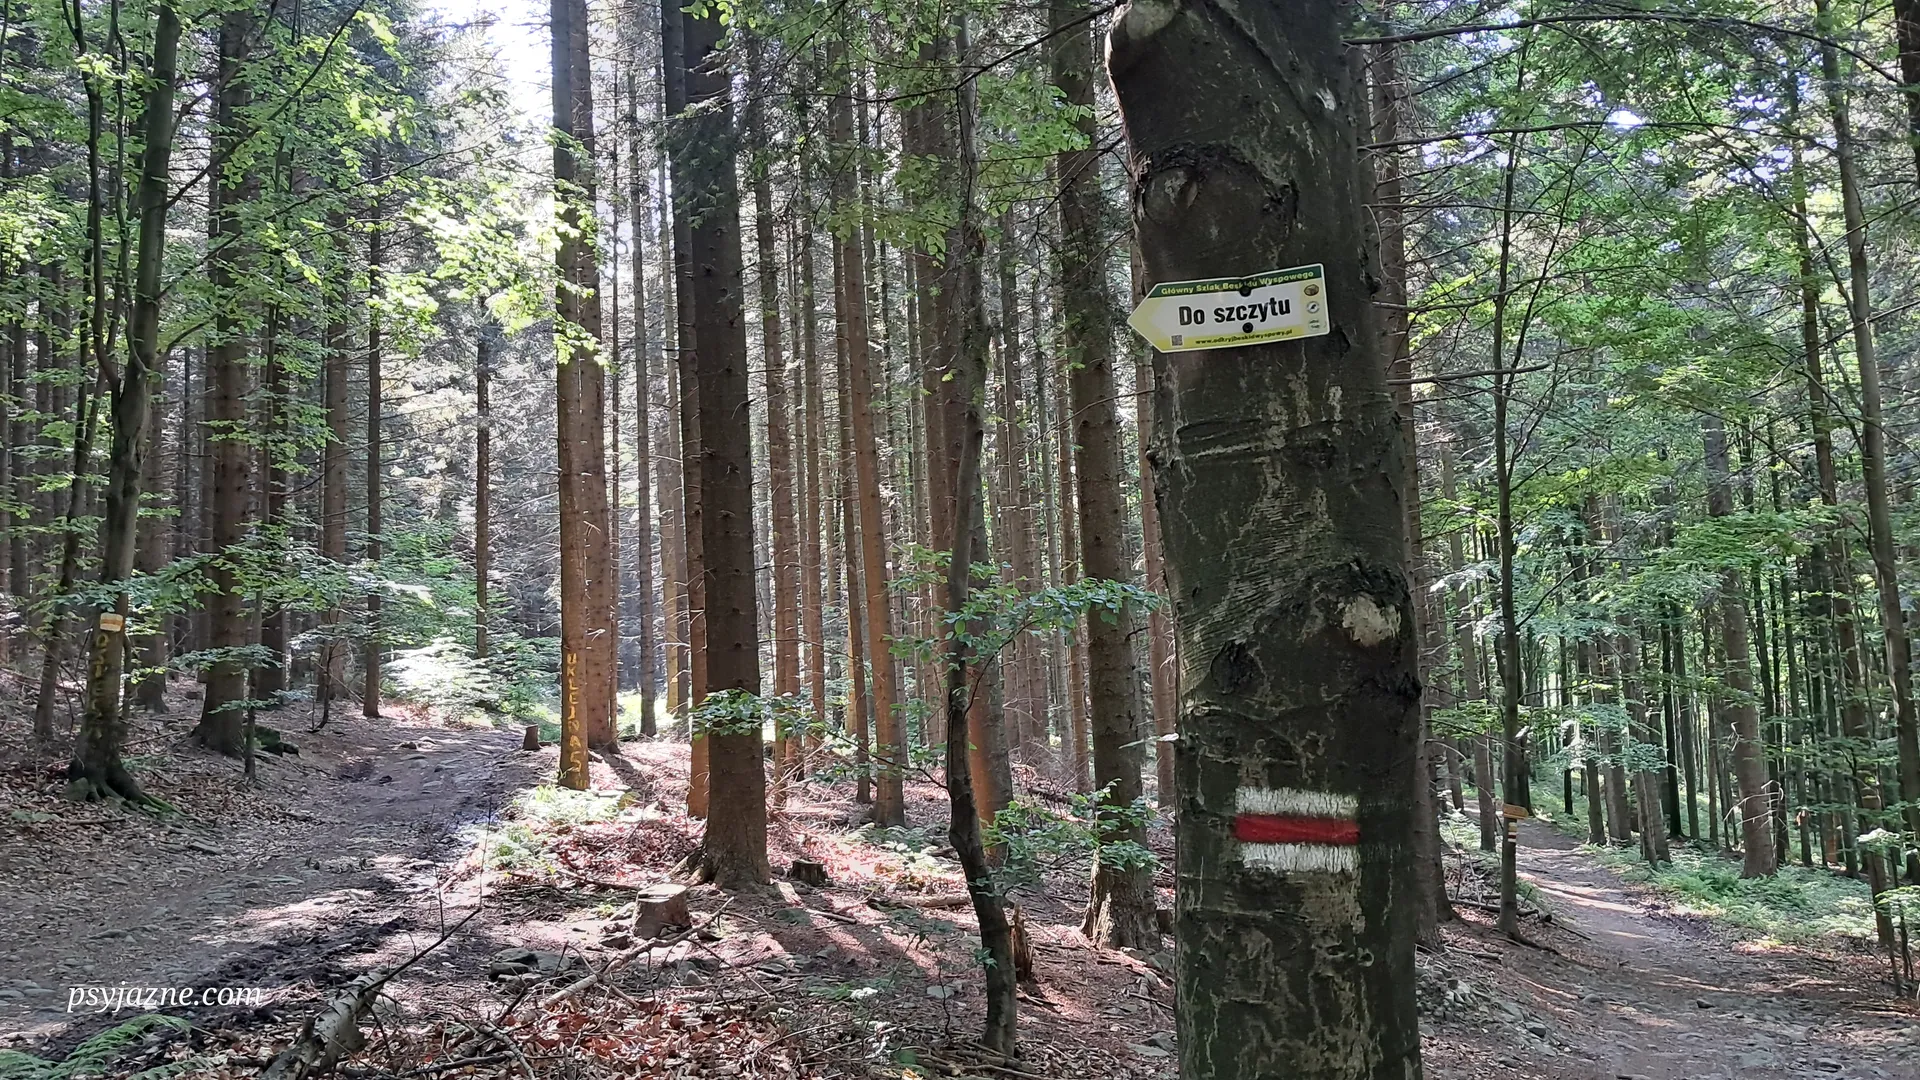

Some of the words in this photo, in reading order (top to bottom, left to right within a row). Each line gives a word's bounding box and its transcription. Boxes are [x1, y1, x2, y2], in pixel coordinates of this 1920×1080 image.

[1161, 285, 1194, 295] Główny
[1196, 283, 1220, 292] Szlak
[1259, 271, 1314, 286] Wyspowego
[1179, 305, 1205, 326] Do
[1213, 297, 1291, 323] szczytu
[1195, 329, 1293, 344] www.odkryjbeskidwyspowy.pl
